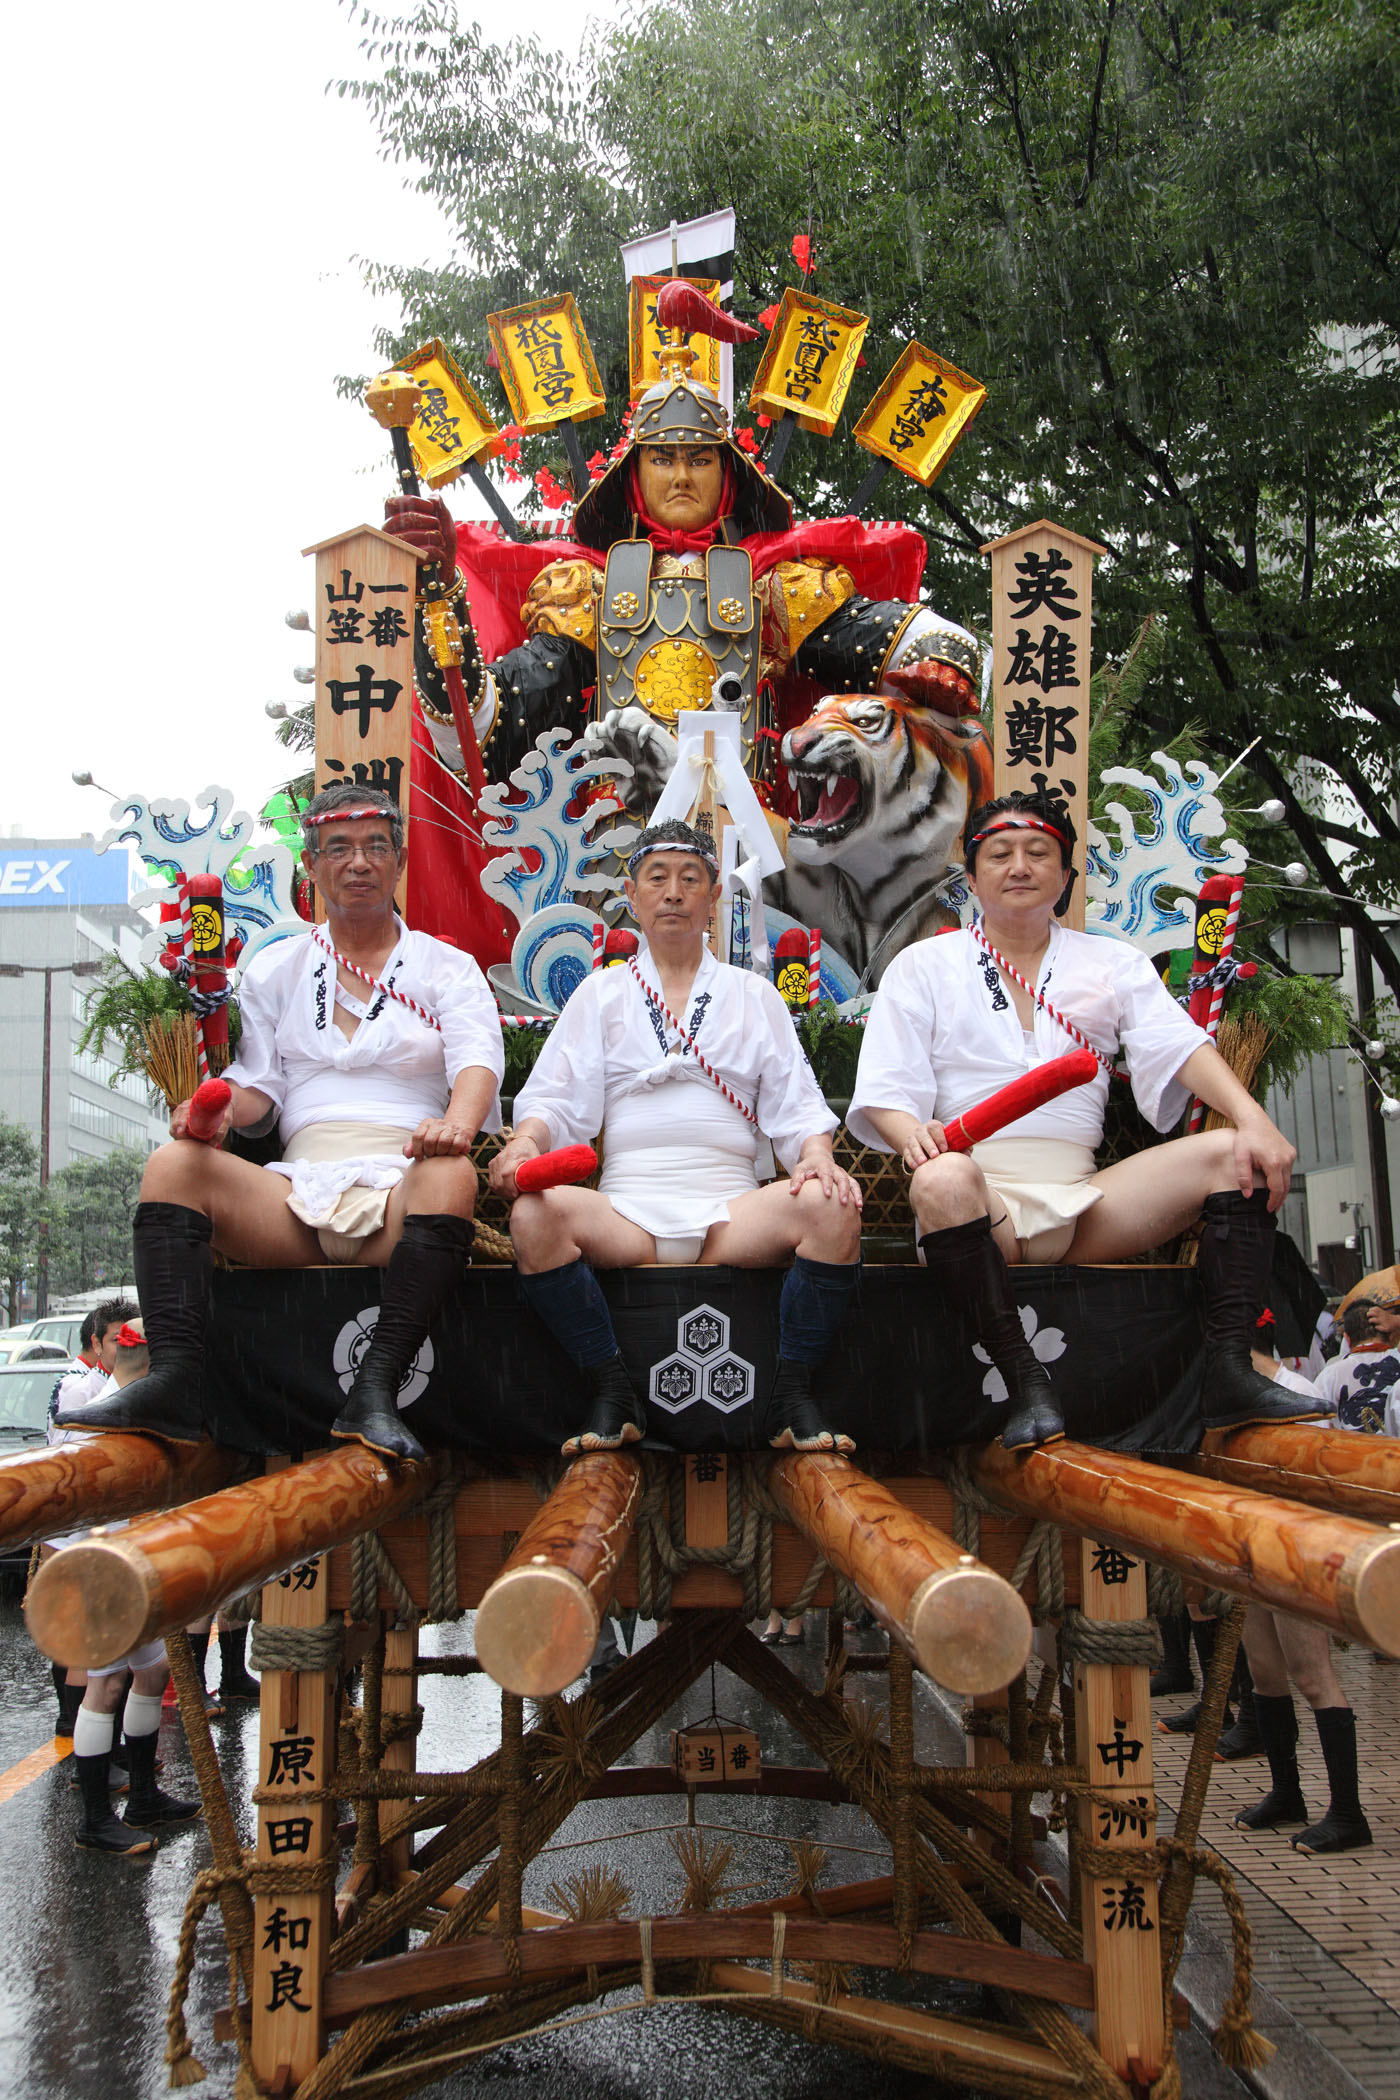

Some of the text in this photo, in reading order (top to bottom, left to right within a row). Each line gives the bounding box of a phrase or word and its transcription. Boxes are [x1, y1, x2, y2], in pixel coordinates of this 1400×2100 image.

[325, 569, 366, 645] 山笠
[366, 582, 410, 648] 一番
[0, 860, 72, 894] EX
[697, 1743, 752, 1773] 当番
[262, 1735, 316, 2013] 原田和良
